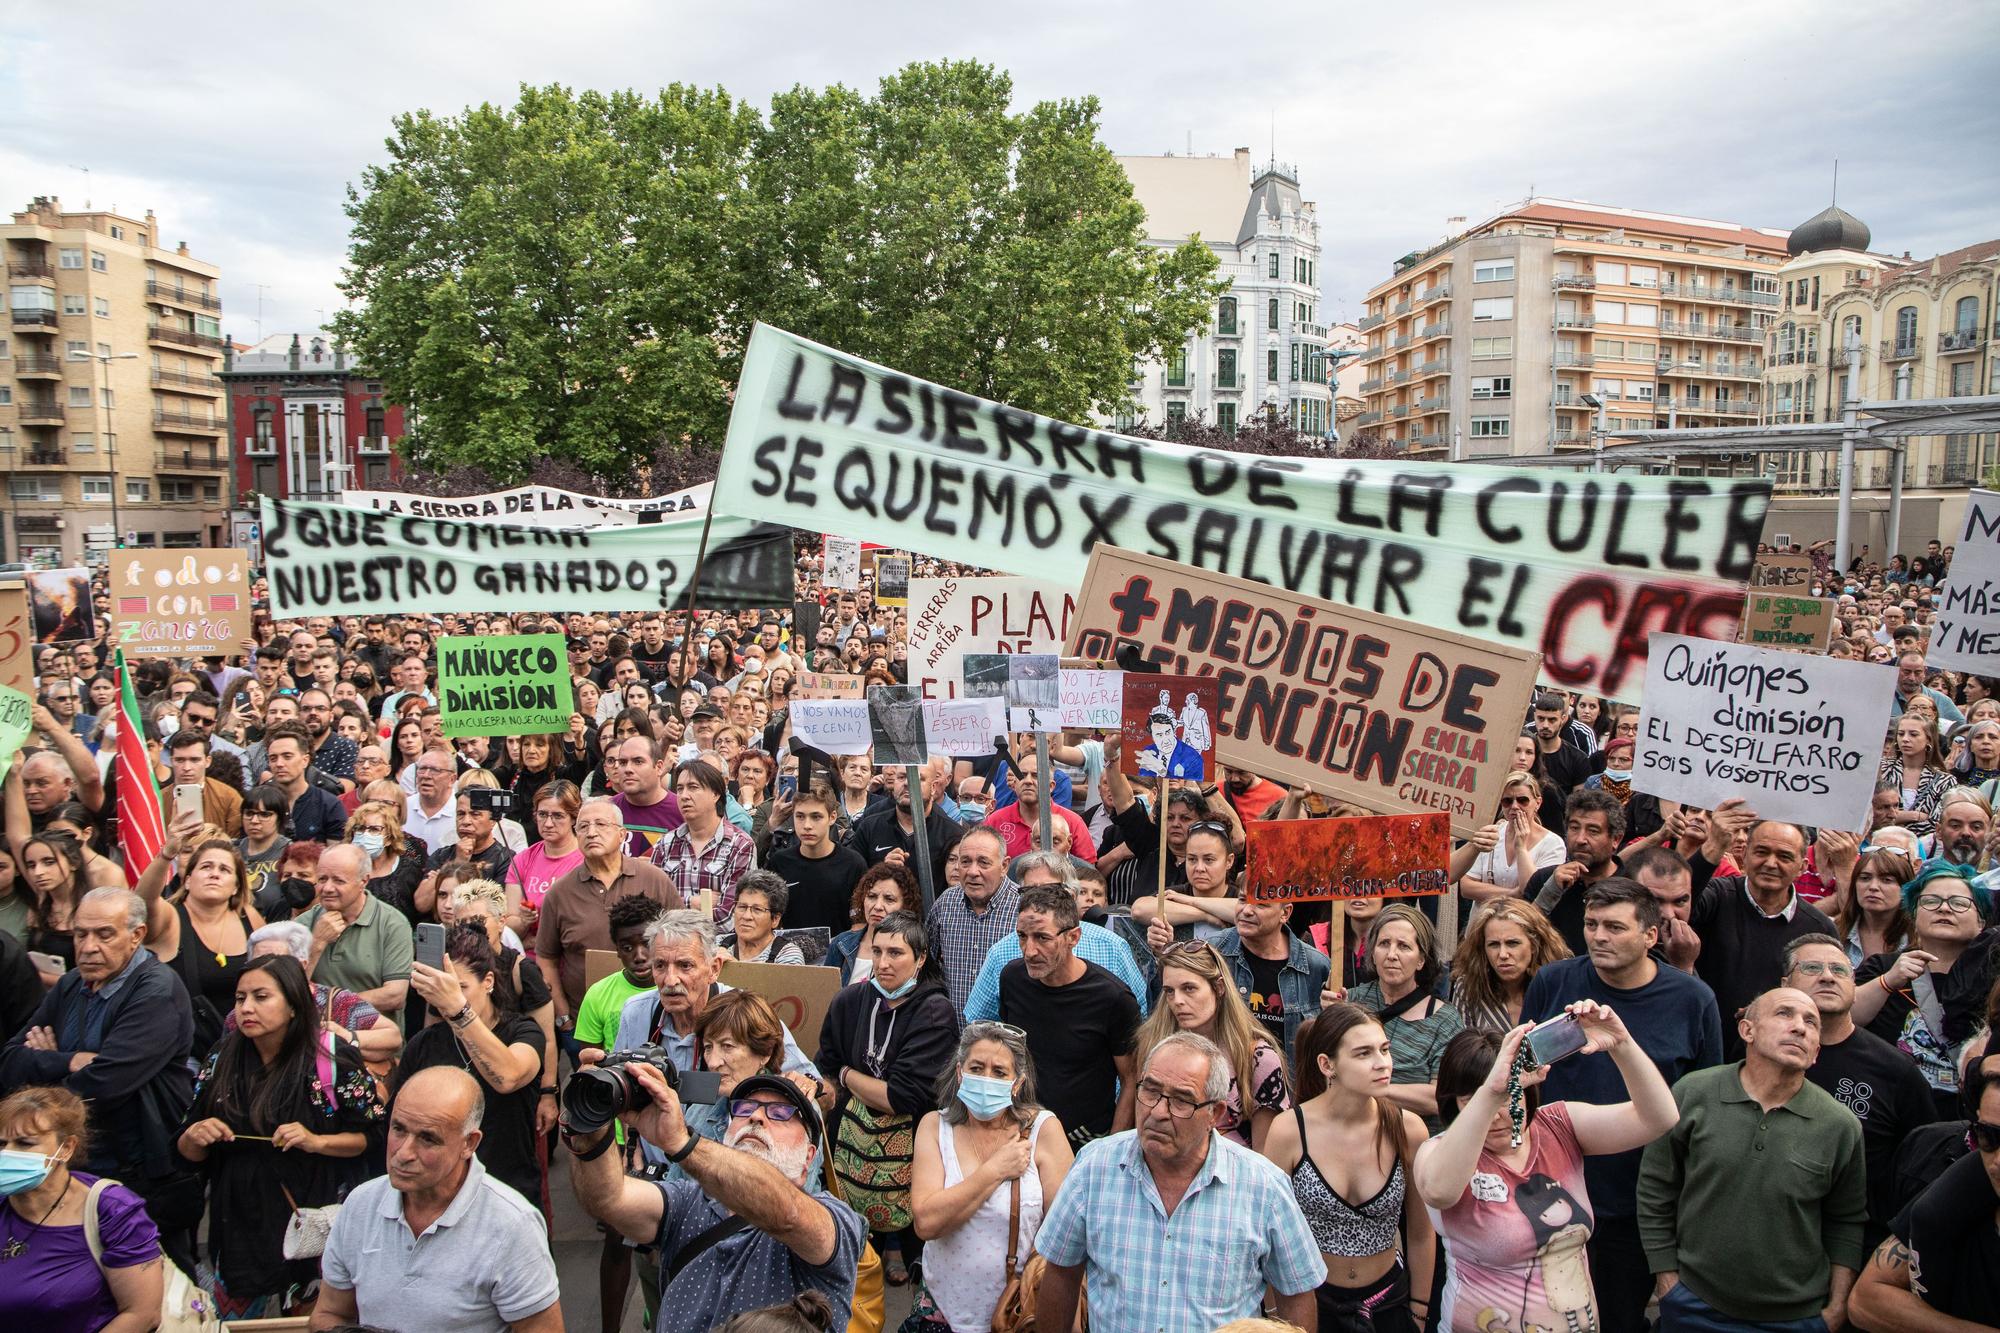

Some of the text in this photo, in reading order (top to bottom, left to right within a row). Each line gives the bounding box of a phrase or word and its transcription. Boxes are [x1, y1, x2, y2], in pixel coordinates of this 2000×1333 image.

[778, 352, 867, 425] LA
[874, 376, 1146, 483] SIERRA
[1187, 453, 1302, 510] DE
[1337, 468, 1453, 537] LA
[409, 500, 499, 518] SIERRA
[504, 493, 535, 514] DE
[541, 491, 574, 511] LA
[751, 435, 824, 507] SE
[1079, 493, 1134, 554] X
[1145, 502, 1424, 615] SALVAR
[1457, 555, 1532, 637] EL
[274, 554, 677, 610] NUESTRO GANADO?
[156, 595, 206, 616] con
[909, 578, 957, 650] FERRERAS
[1937, 620, 1954, 647] Y
[445, 641, 557, 677] MAÑUECO
[1061, 671, 1078, 687] YO
[1087, 671, 1108, 687] TE
[1663, 644, 1810, 703] Quiñones
[1399, 651, 1501, 733] DE
[466, 716, 505, 728] CULEBRA
[828, 707, 867, 719] VAMOS
[932, 714, 991, 732] ESPERO
[1061, 709, 1085, 724] VER
[1714, 694, 1844, 742] dimisión
[803, 721, 862, 738] DE CENA?
[1647, 717, 1672, 742] EL
[1421, 726, 1489, 763] EN LA
[1402, 748, 1478, 794] SIERRA
[1399, 782, 1475, 819] CULEBRA
[1255, 879, 1304, 901] León
[1836, 1077, 1873, 1100] SO
